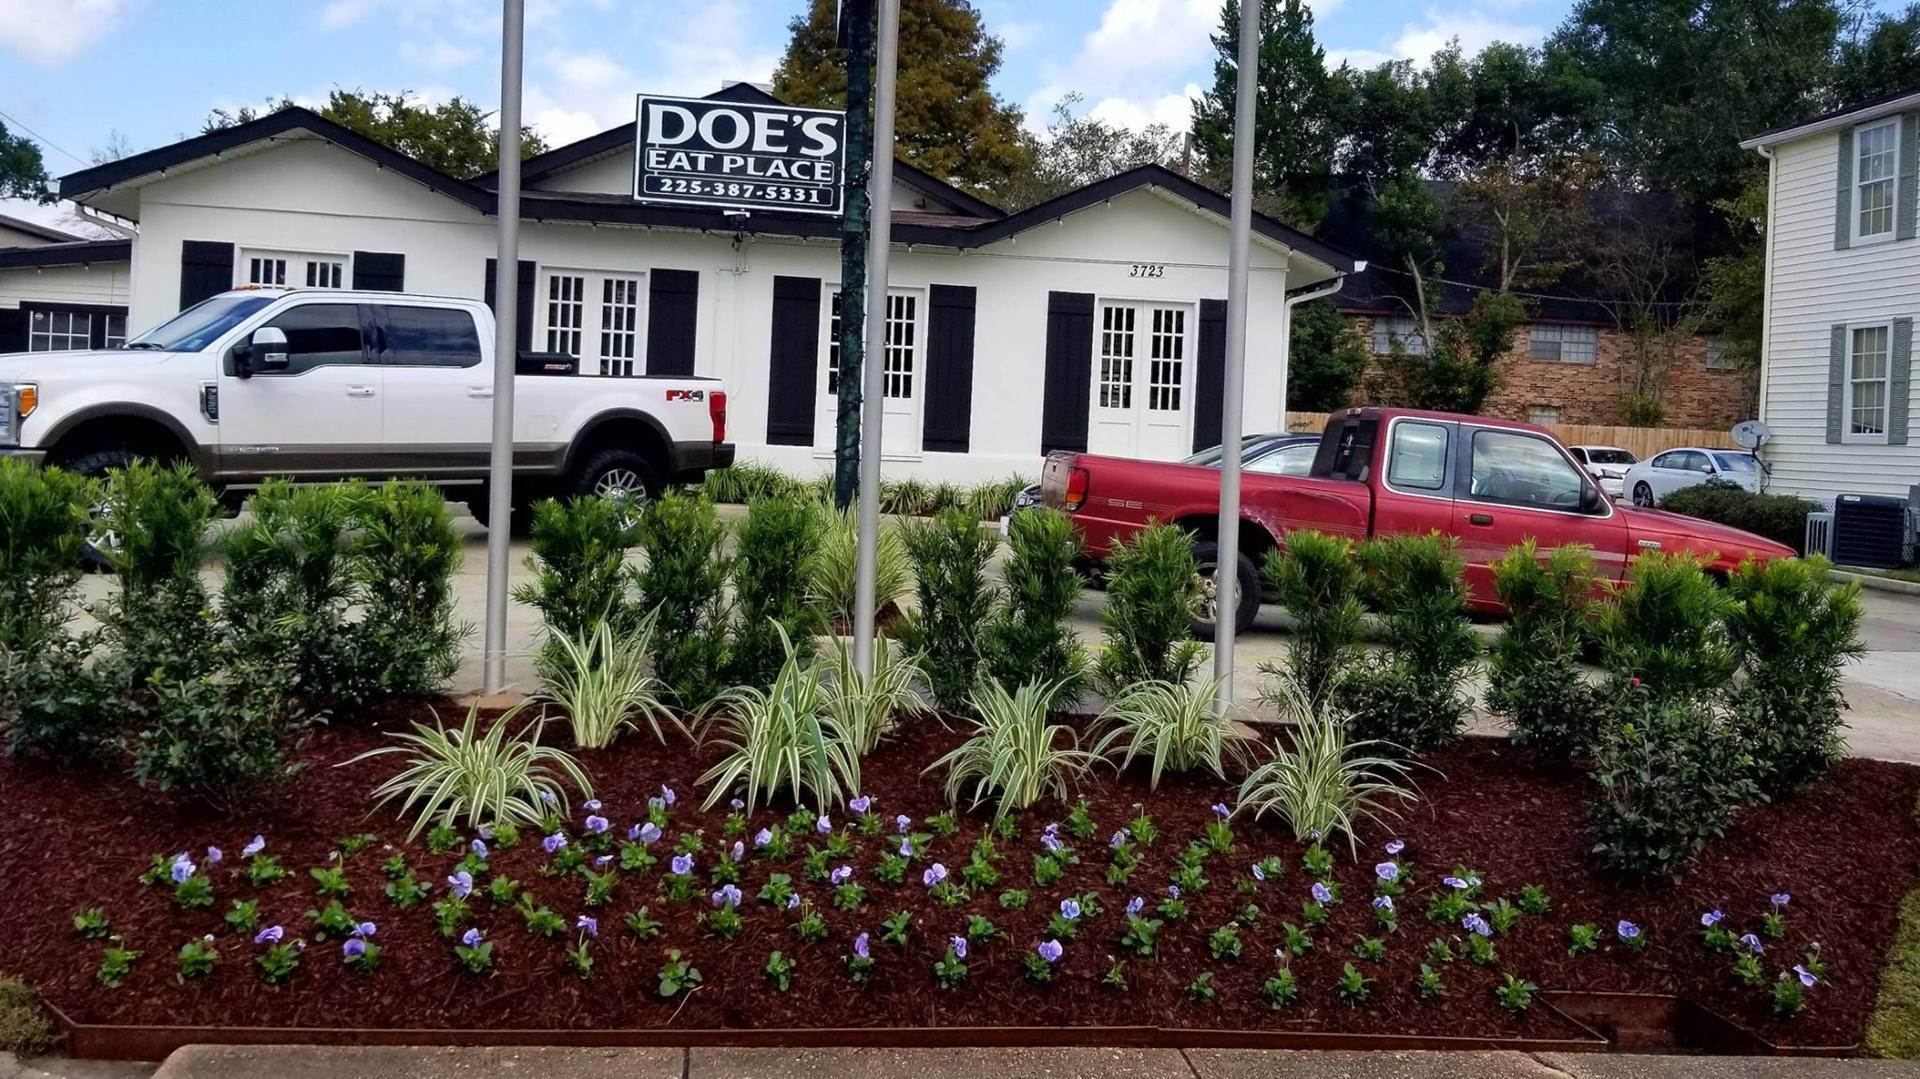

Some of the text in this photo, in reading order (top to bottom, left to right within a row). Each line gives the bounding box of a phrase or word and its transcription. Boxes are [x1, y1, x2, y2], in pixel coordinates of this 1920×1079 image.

[646, 103, 838, 157] DOE'S
[648, 149, 832, 181] EAT PLACE
[660, 178, 820, 203] 225-387-5331
[1130, 265, 1164, 278] 3723
[666, 390, 704, 401] FX4
[1108, 498, 1143, 509] SE
